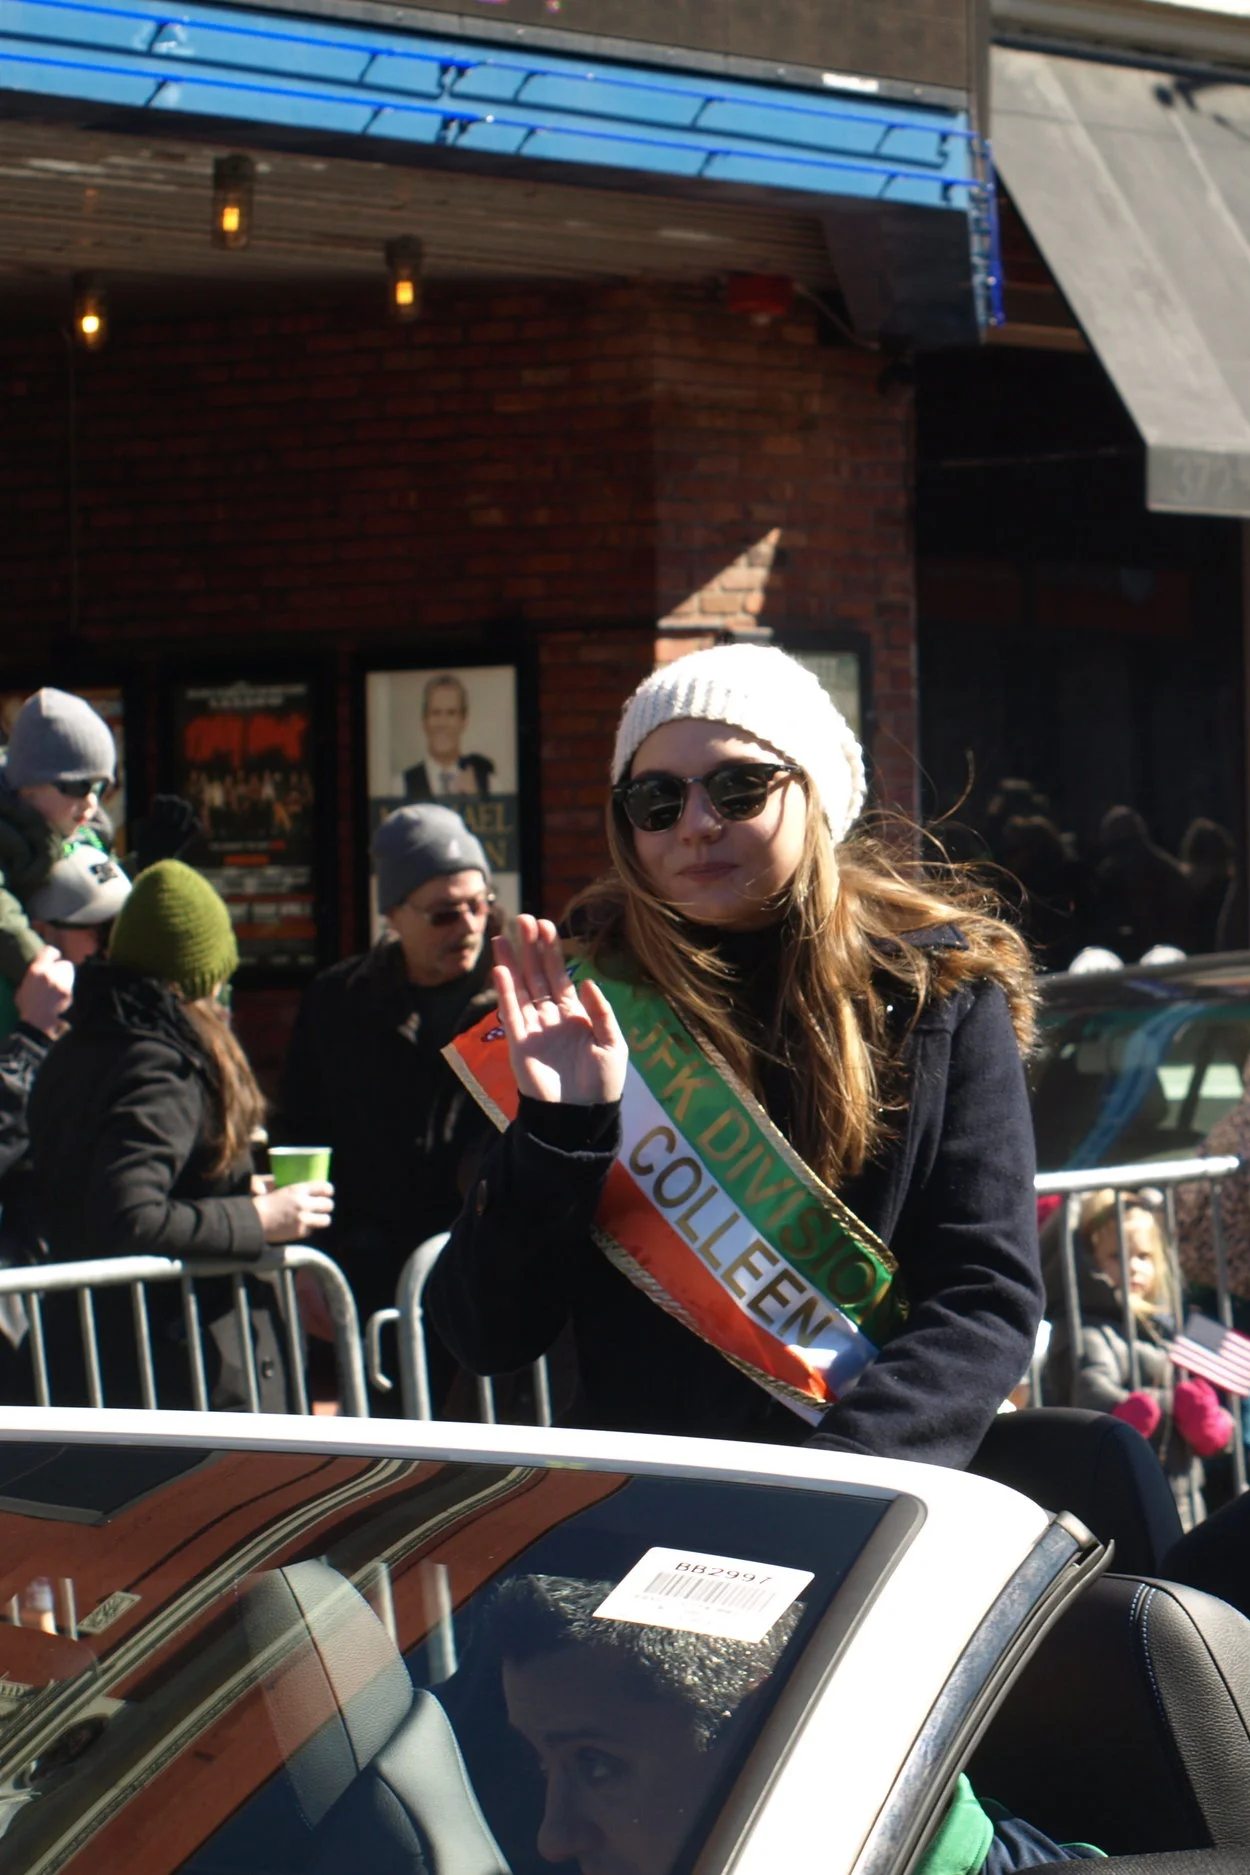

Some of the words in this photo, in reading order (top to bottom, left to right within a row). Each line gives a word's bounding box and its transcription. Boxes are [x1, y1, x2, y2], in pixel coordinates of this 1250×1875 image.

[628, 1018, 718, 1122] JFK
[629, 1125, 838, 1347] COLLEEN
[675, 1562, 772, 1585] BB2997
